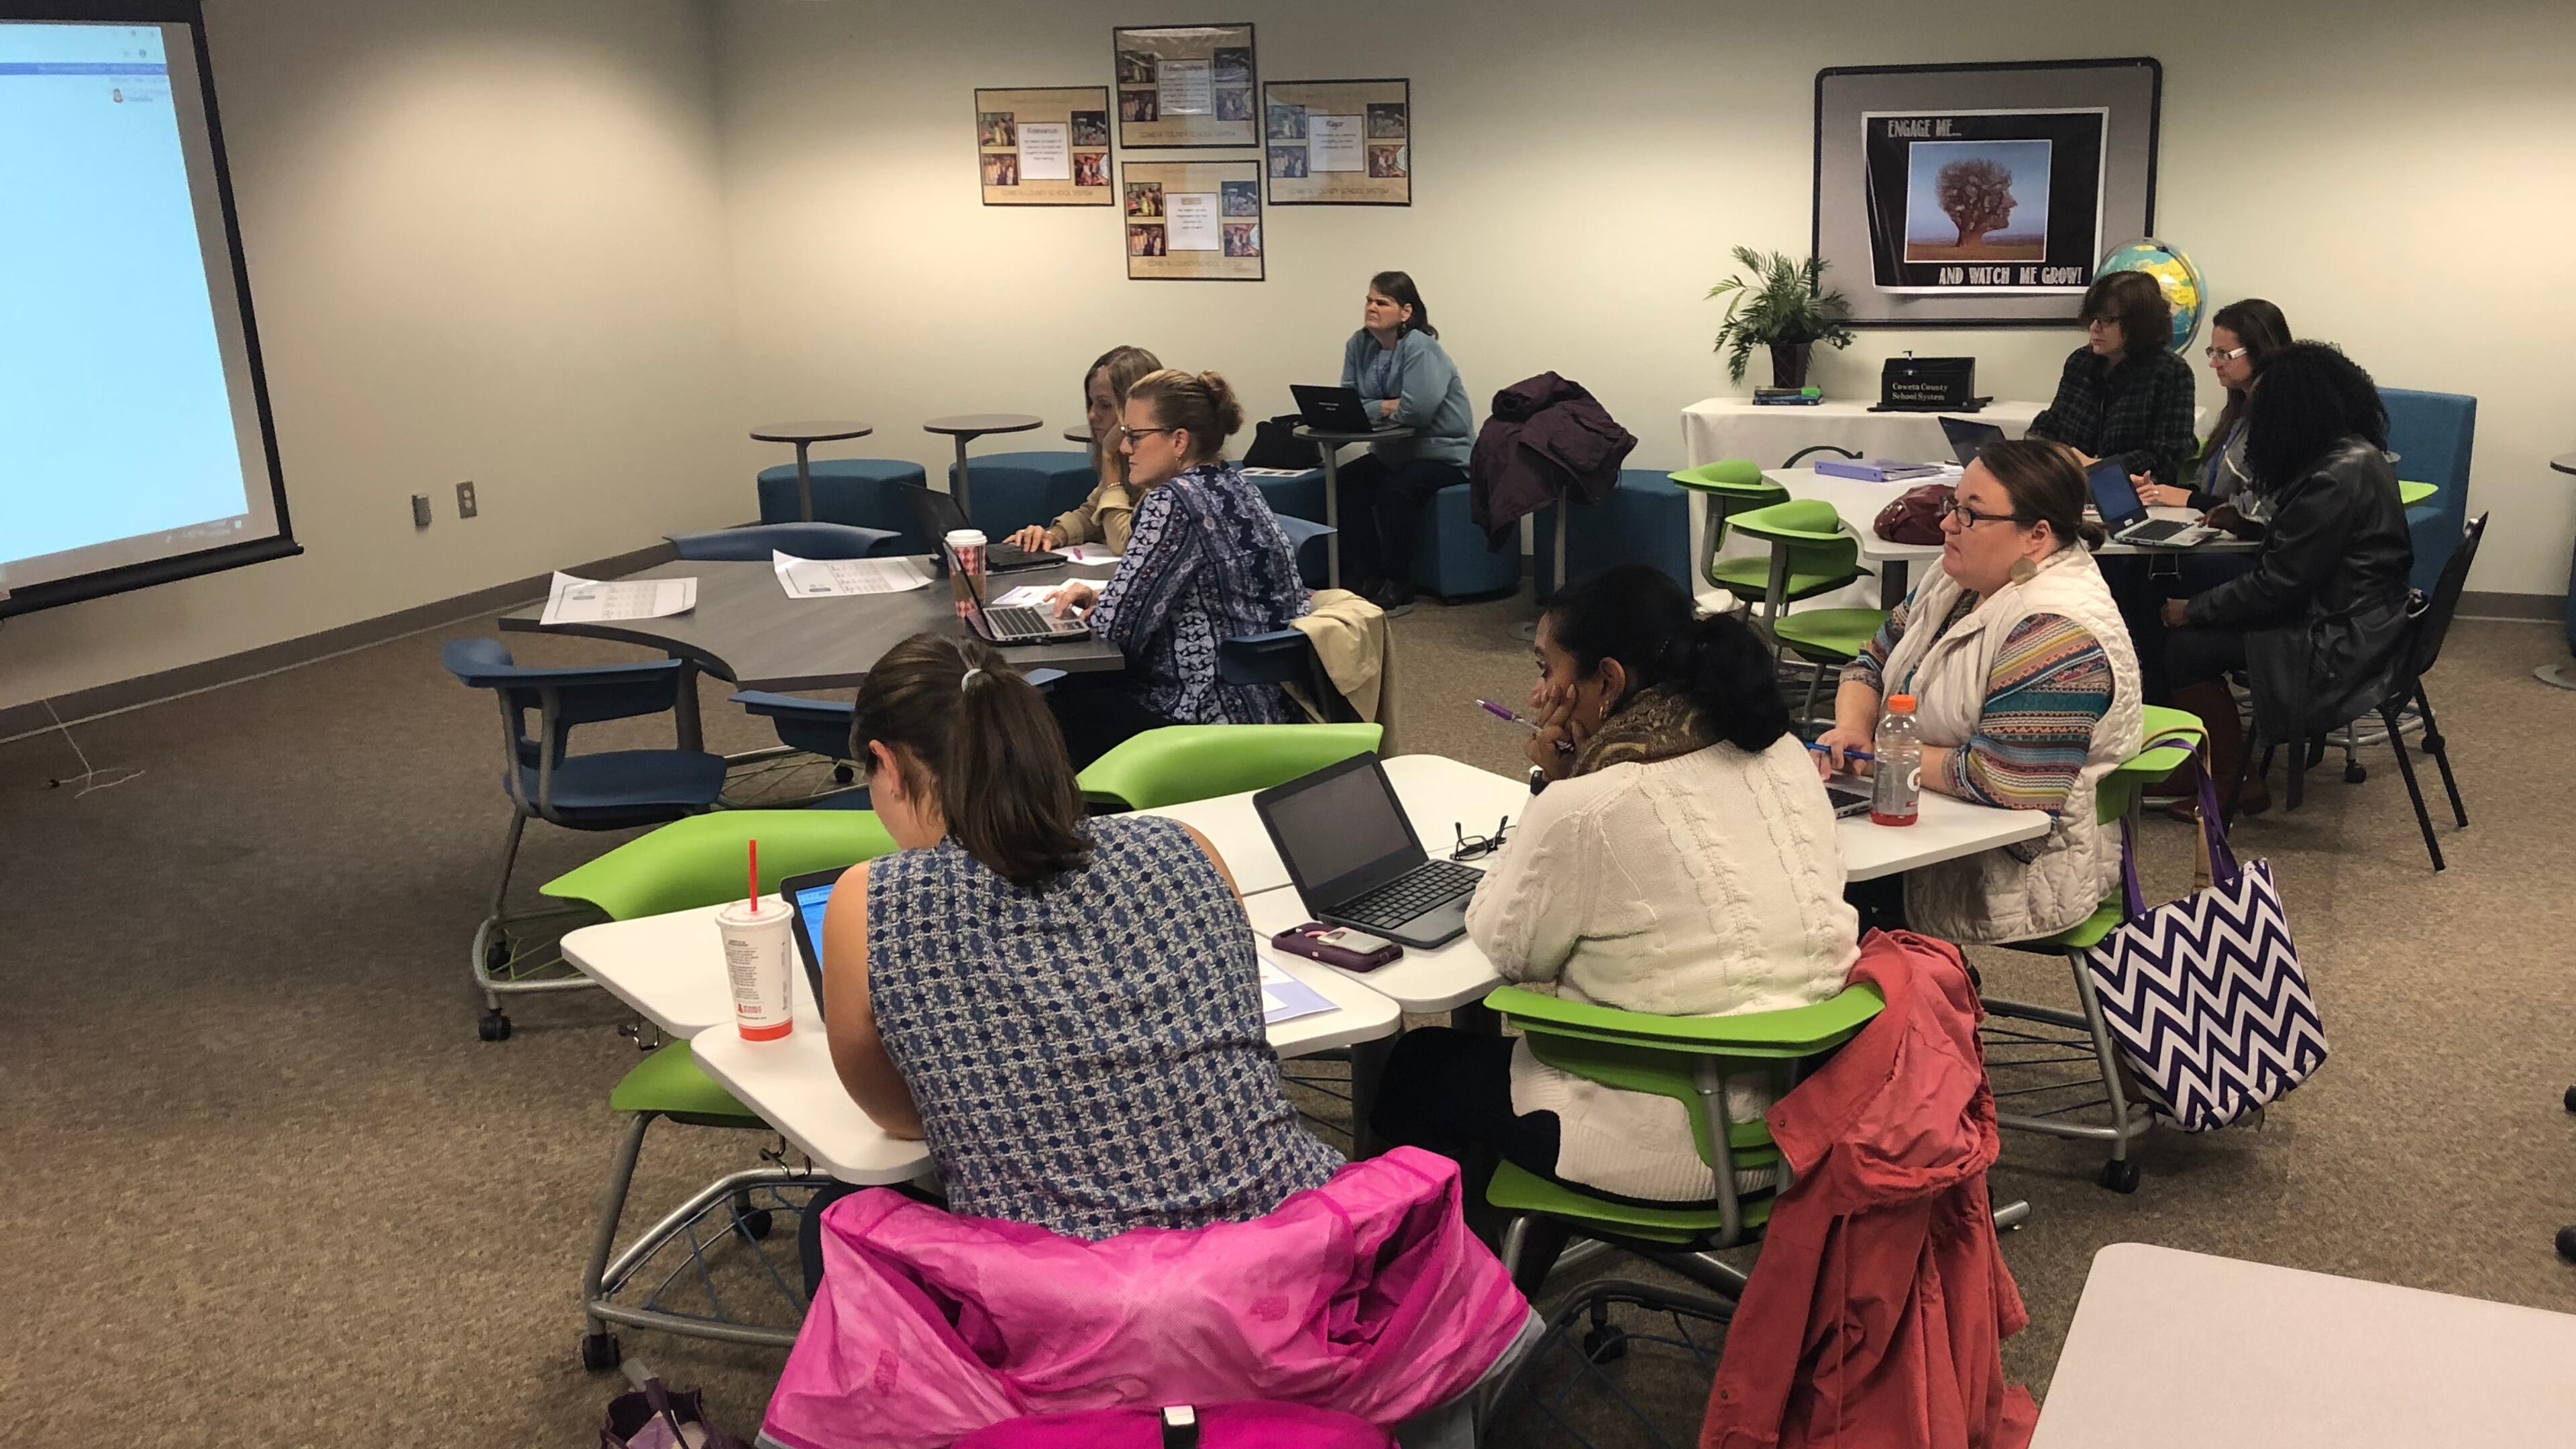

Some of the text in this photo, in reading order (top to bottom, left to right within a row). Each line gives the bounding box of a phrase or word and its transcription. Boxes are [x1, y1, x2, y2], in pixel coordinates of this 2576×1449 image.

[1888, 119, 1931, 138] ENGAGE
[1939, 267, 2082, 284] AND WATCH ME GROW!
[1921, 382, 1948, 392] County
[1892, 392, 1945, 402] School System
